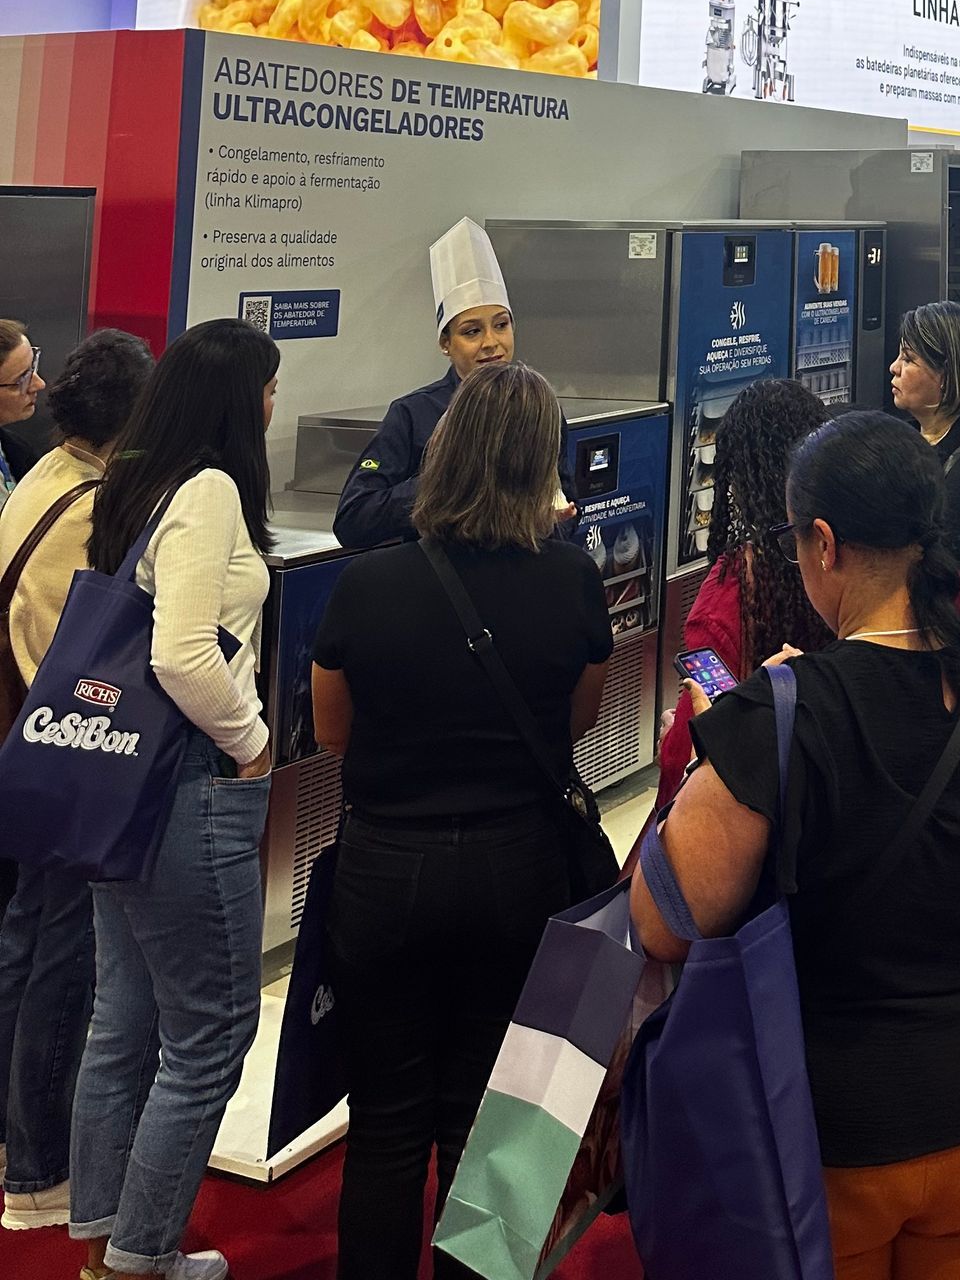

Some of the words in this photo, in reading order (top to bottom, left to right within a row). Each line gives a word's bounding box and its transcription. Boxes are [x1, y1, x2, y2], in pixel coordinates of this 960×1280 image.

[903, 44, 950, 65] Indispensáveis
[950, 56, 958, 68] na
[855, 58, 865, 70] as
[866, 56, 903, 76] batedeiras
[903, 64, 939, 82] planetárias
[214, 56, 384, 100] ABATEDORES
[392, 78, 421, 105] DE
[427, 82, 570, 121] TEMPERATURA
[879, 83, 885, 93] e
[885, 82, 918, 100] preparam
[919, 88, 943, 103] massas
[943, 92, 957, 105] com
[212, 92, 485, 142] ULTRACONGELADORES
[218, 145, 310, 166] Congelamento,
[314, 151, 385, 168] resfriamento
[206, 167, 248, 184] rápido
[251, 175, 259, 184] e
[262, 172, 296, 188] apoio
[299, 172, 307, 187] à
[310, 173, 381, 192] fermentação
[204, 191, 240, 210] (linha
[244, 194, 303, 212] Klimapro)
[212, 229, 267, 244] Preserva
[269, 233, 277, 244] a
[280, 229, 338, 248] qualidade
[200, 253, 248, 271] original
[251, 253, 273, 268] dos
[276, 253, 335, 268] alimentos
[273, 312, 283, 320] OS
[283, 310, 315, 319] ABATEDOR
[316, 309, 325, 318] DE
[274, 302, 293, 311] SAIBA
[293, 301, 309, 310] MAIS
[309, 300, 330, 309] SOBRE
[273, 318, 317, 328] TEMPERATURA
[711, 335, 738, 348] CONGELE,
[738, 333, 761, 345] RESFRIE,
[706, 349, 729, 362] AQUEÇA
[729, 347, 734, 358] E
[734, 344, 768, 358] DIVERSIFIQUE
[699, 364, 711, 375] SUA
[711, 358, 740, 372] OPERAÇÃO
[740, 357, 752, 368] SEM
[752, 355, 772, 366] PERDAS
[584, 500, 606, 513] RESFRIE
[606, 499, 611, 508] E
[611, 495, 631, 508] AQUEÇA
[608, 508, 616, 517] NA
[615, 501, 646, 516] CONFEITARIA
